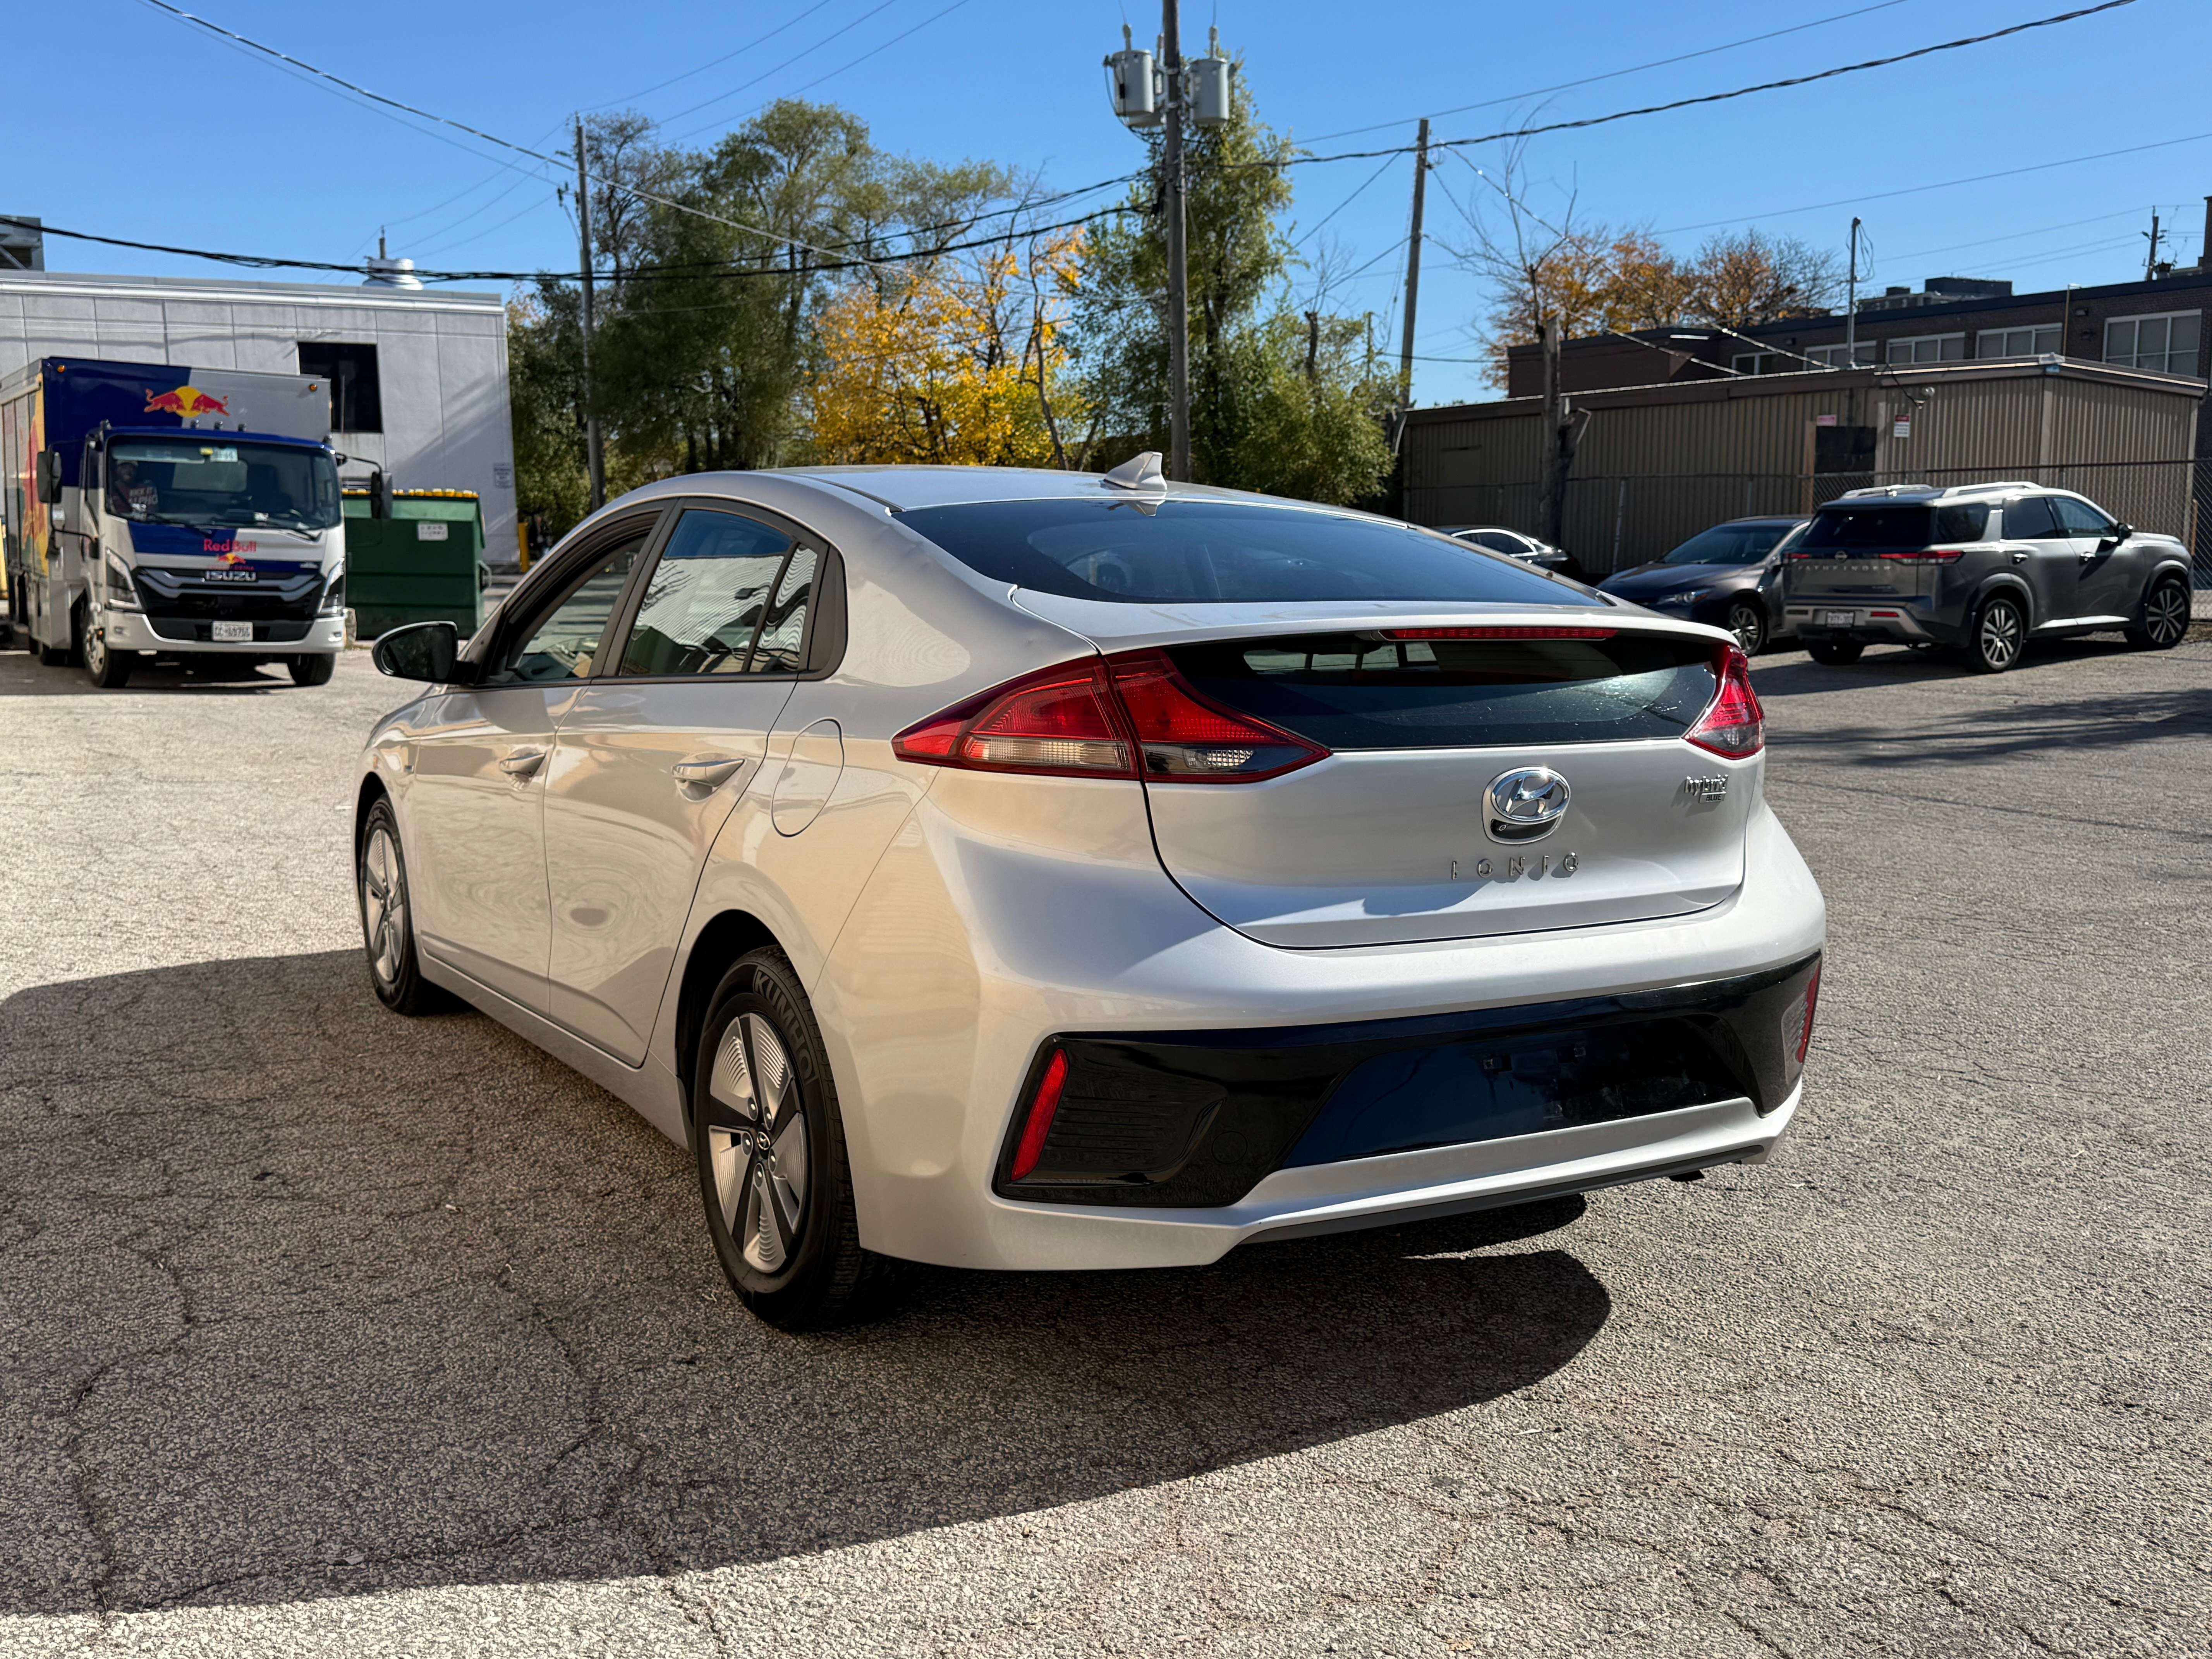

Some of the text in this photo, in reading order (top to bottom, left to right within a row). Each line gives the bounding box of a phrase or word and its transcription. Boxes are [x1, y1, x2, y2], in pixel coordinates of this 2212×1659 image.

[204, 539, 256, 552] Red Bull
[205, 571, 256, 581] ISUZU
[1685, 774, 1728, 796] hybrid
[1451, 852, 1579, 880] IONIQ
[755, 970, 813, 1079] KUMHO
